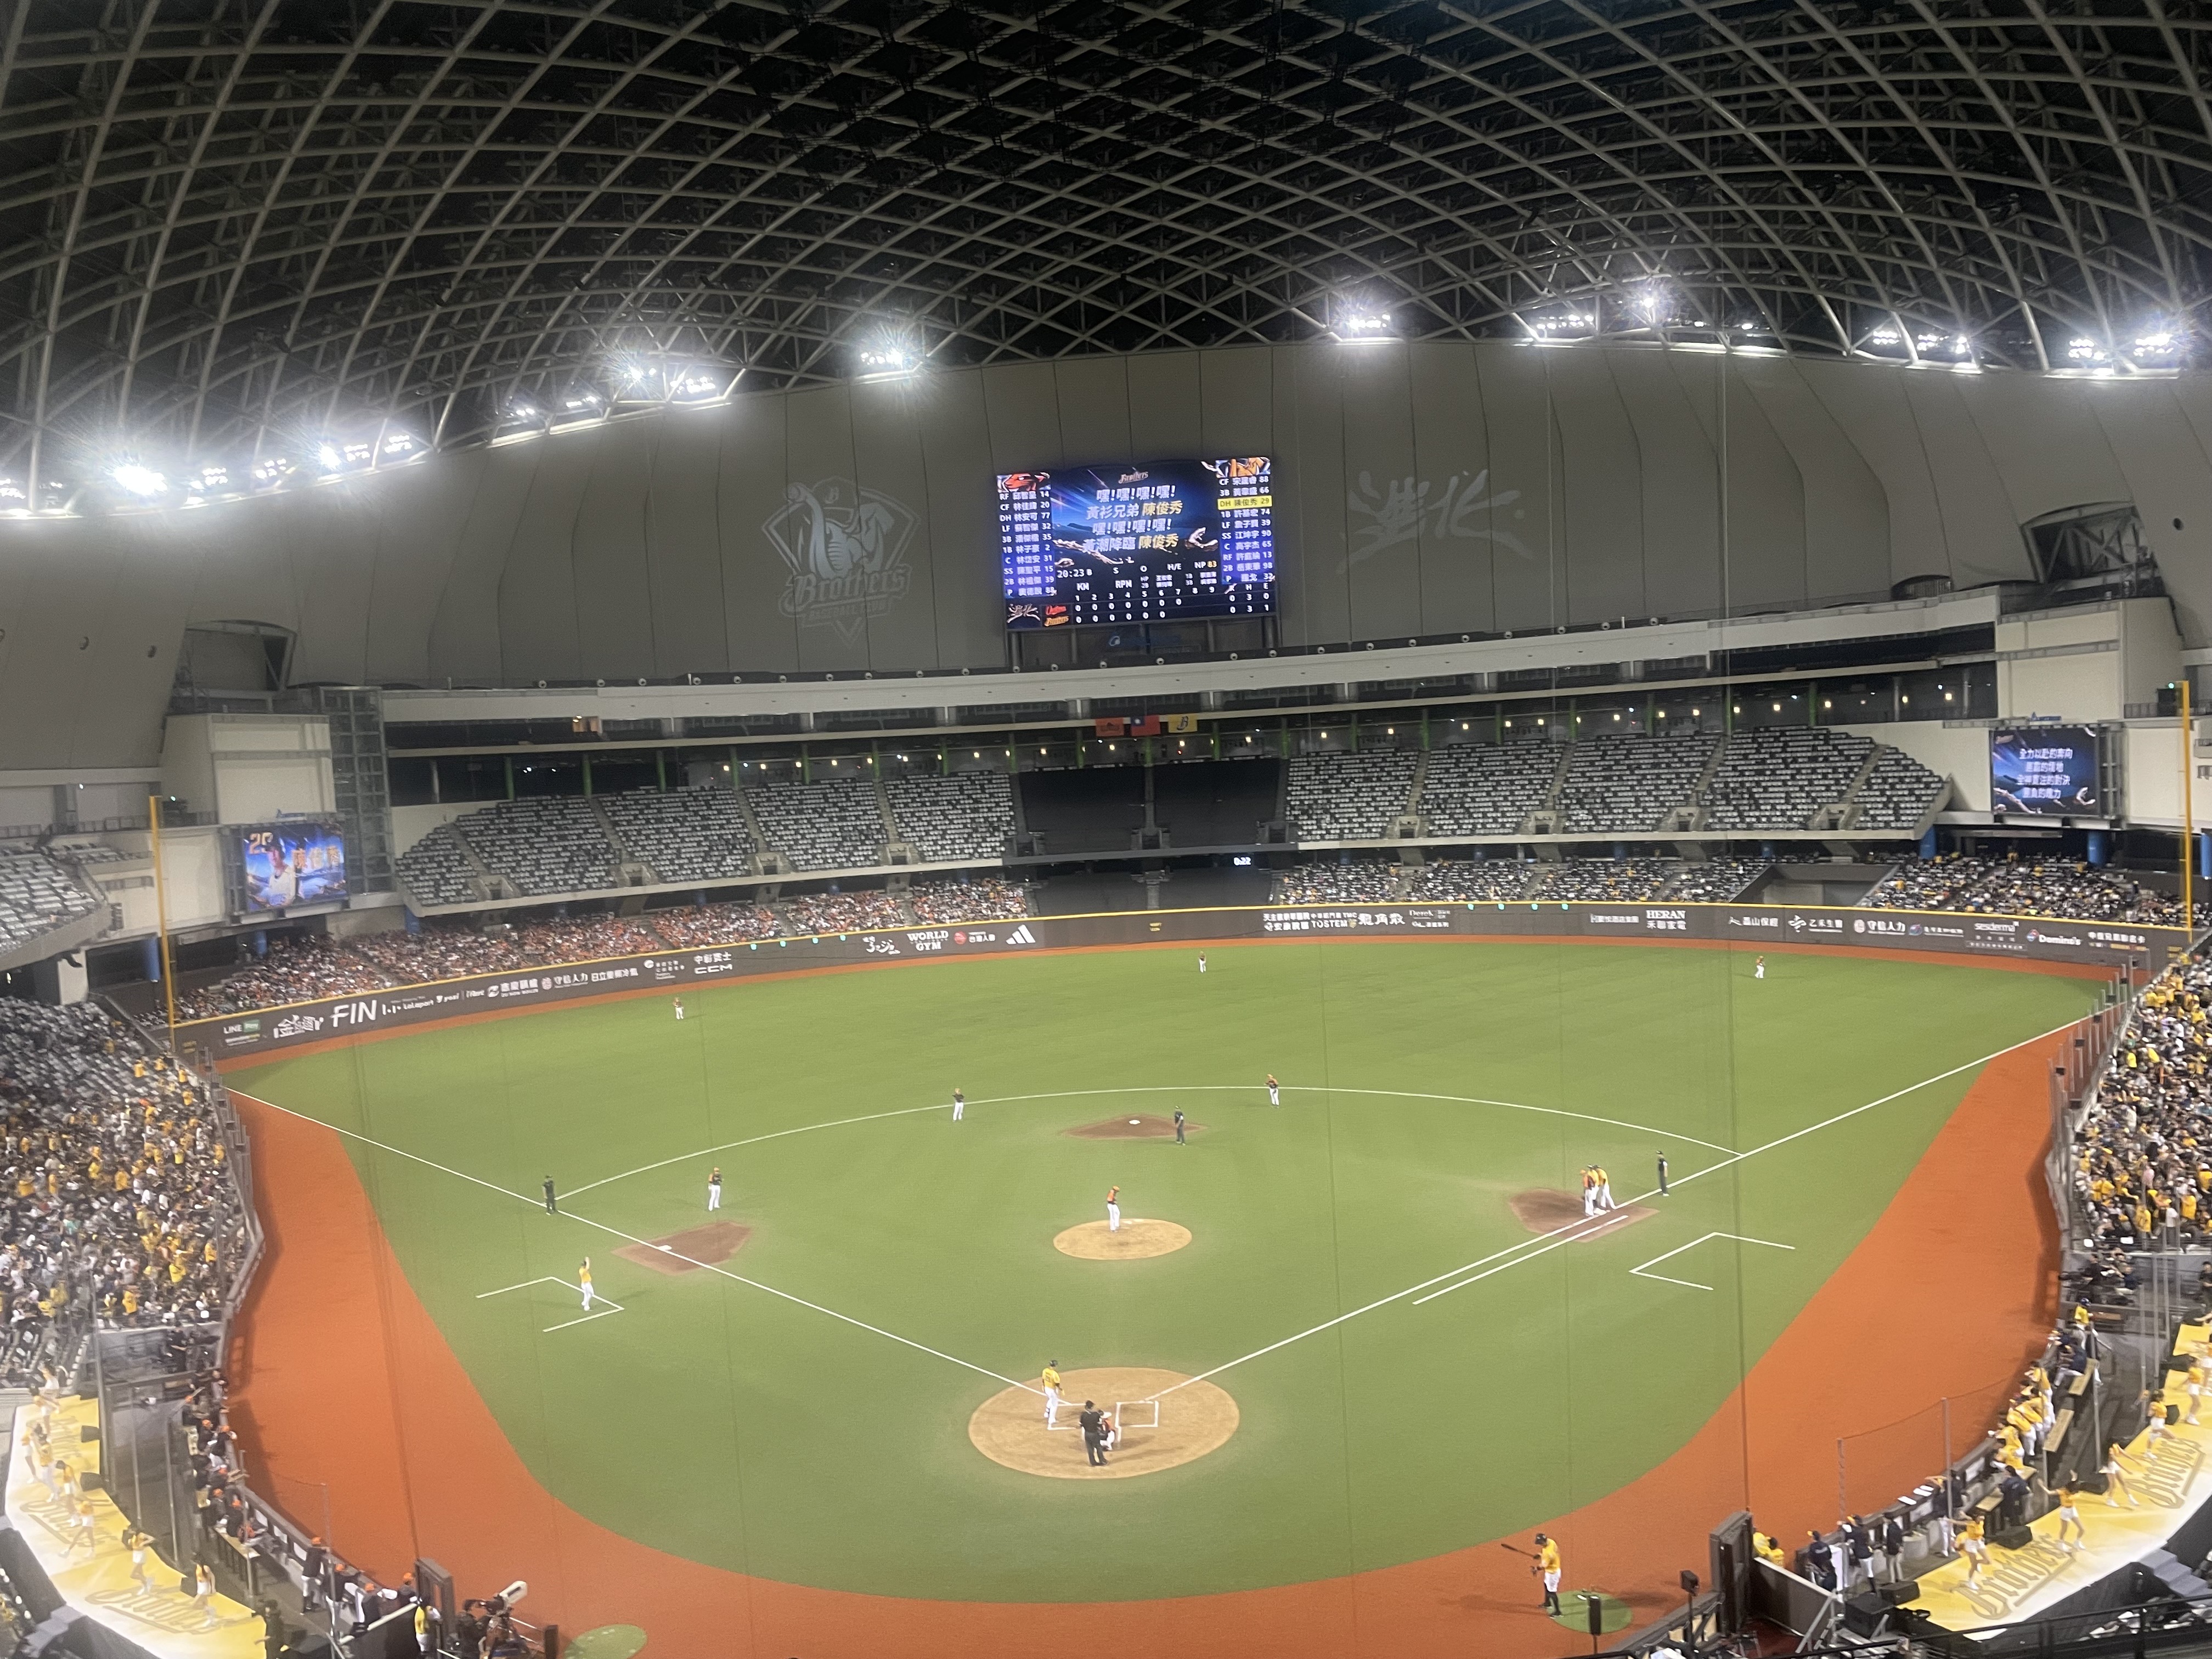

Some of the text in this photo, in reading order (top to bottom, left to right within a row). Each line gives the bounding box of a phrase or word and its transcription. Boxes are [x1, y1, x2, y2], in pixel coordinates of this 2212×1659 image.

[1142, 500, 1183, 516] 陳俊秀
[1138, 533, 1179, 549] 陳俊秀
[1057, 569, 1084, 578] 20:23
[778, 562, 913, 617] Brothers
[1646, 910, 1686, 919] HERAN
[1311, 919, 1347, 928] TOSTEM
[1974, 922, 2016, 932] sesderma
[907, 930, 949, 942] WORLD
[2039, 934, 2081, 945] Domino's
[915, 941, 941, 951] GYM
[695, 963, 732, 974] CCM
[330, 1000, 377, 1028] FIN
[223, 1024, 242, 1034] LINE
